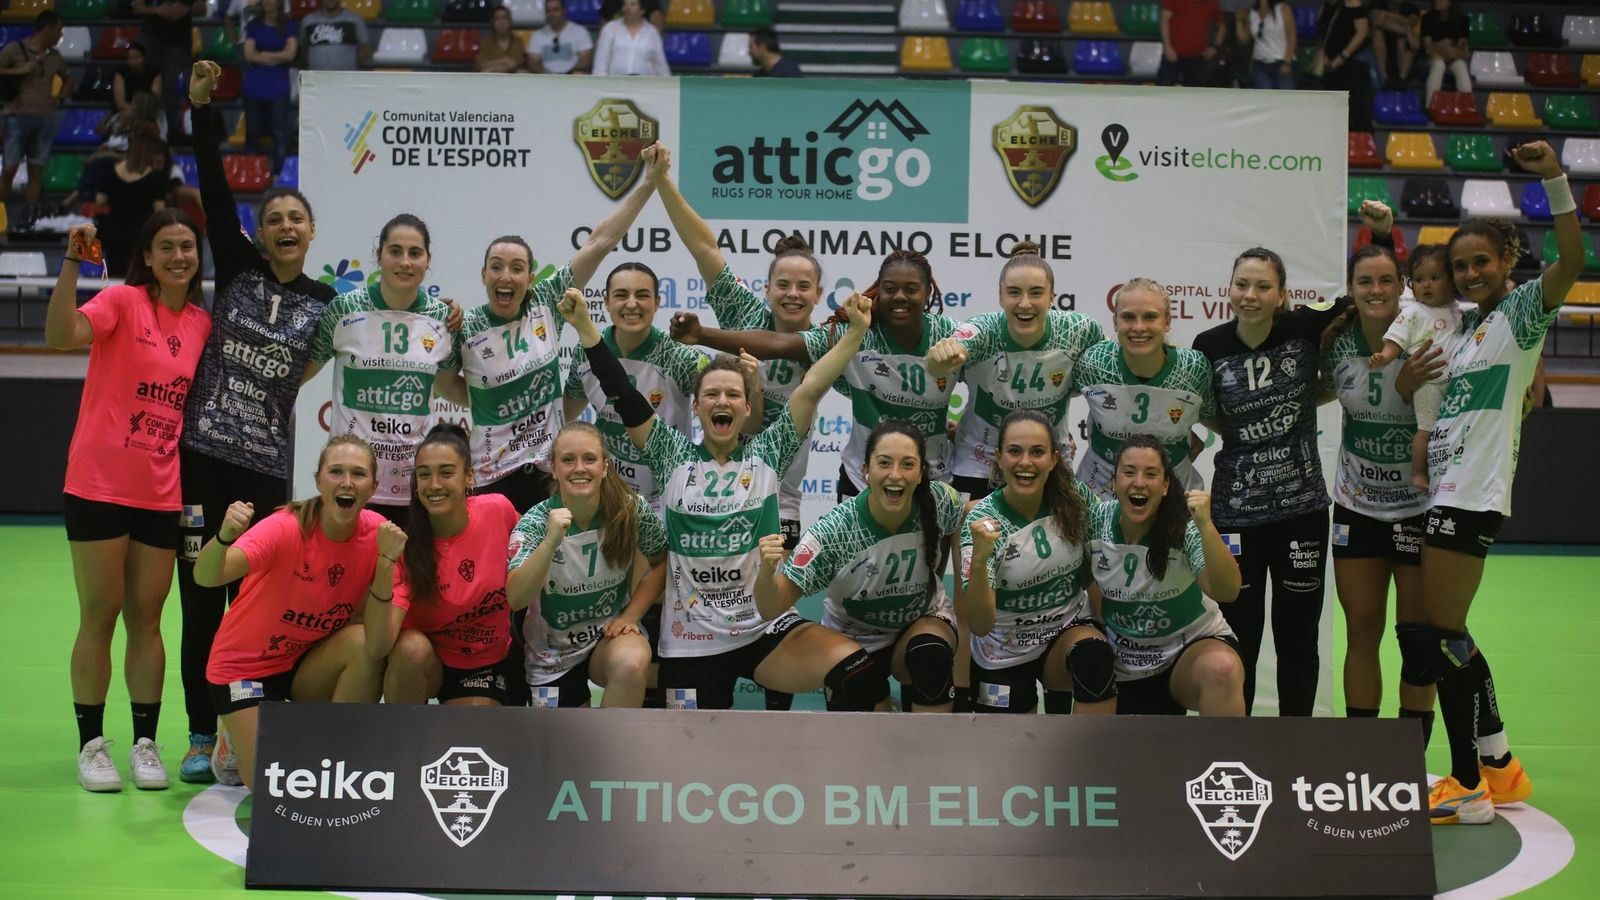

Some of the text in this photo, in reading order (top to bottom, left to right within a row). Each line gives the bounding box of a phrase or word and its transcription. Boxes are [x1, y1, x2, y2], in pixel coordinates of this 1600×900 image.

[383, 110, 514, 123] Comunitat Valenciana
[382, 126, 514, 146] COMUNITAT
[592, 129, 638, 138] ELCHE
[1010, 136, 1057, 144] ELCHE
[392, 148, 531, 168] DE L'ESPORT
[712, 131, 932, 201] atticgo
[1139, 146, 1322, 172] visitelche.com
[712, 187, 852, 200] RUGS FOR YOUR HOME
[571, 226, 1072, 260] CUB ALONMANO ELCHE
[268, 294, 282, 324] 1
[240, 318, 307, 350] visitelche.com
[382, 322, 409, 354] 13
[502, 326, 529, 360] 14
[222, 339, 290, 378] atticgo
[362, 356, 436, 371] visitelche.com
[897, 362, 926, 396] 10
[1010, 362, 1046, 394] 44
[1243, 356, 1274, 391] 12
[136, 381, 185, 411] atticg
[228, 376, 266, 400] teika
[356, 385, 424, 411] atticgo
[1232, 382, 1307, 415] visitelche.com
[1368, 372, 1383, 406] 5
[1130, 392, 1150, 424] 3
[370, 418, 412, 434] teika
[1238, 412, 1302, 442] atticg
[614, 458, 636, 478] ika
[1360, 464, 1402, 482] teika
[703, 470, 736, 498] 22
[687, 496, 762, 514] visitelche.com
[680, 530, 753, 552] atticgo
[1032, 525, 1052, 560] 8
[1396, 542, 1418, 553] tesla
[581, 542, 598, 578] 7
[885, 548, 918, 586] 27
[1124, 552, 1138, 587] 9
[1293, 559, 1317, 568] tesla
[690, 566, 742, 584] teika
[1016, 558, 1080, 589] visitelche.c
[1102, 587, 1180, 600] visitelche.com
[567, 624, 605, 645] teik
[682, 632, 714, 640] ribera
[264, 758, 395, 800] teika
[438, 776, 490, 787] ELCHE
[1292, 772, 1420, 812] teika
[546, 780, 1120, 827] ATTICGO BM ELCHE
[1204, 791, 1254, 800] ELCHE
[275, 804, 382, 827] EL BUEN VENDING
[1306, 817, 1410, 840] EL BUEN VENDING
